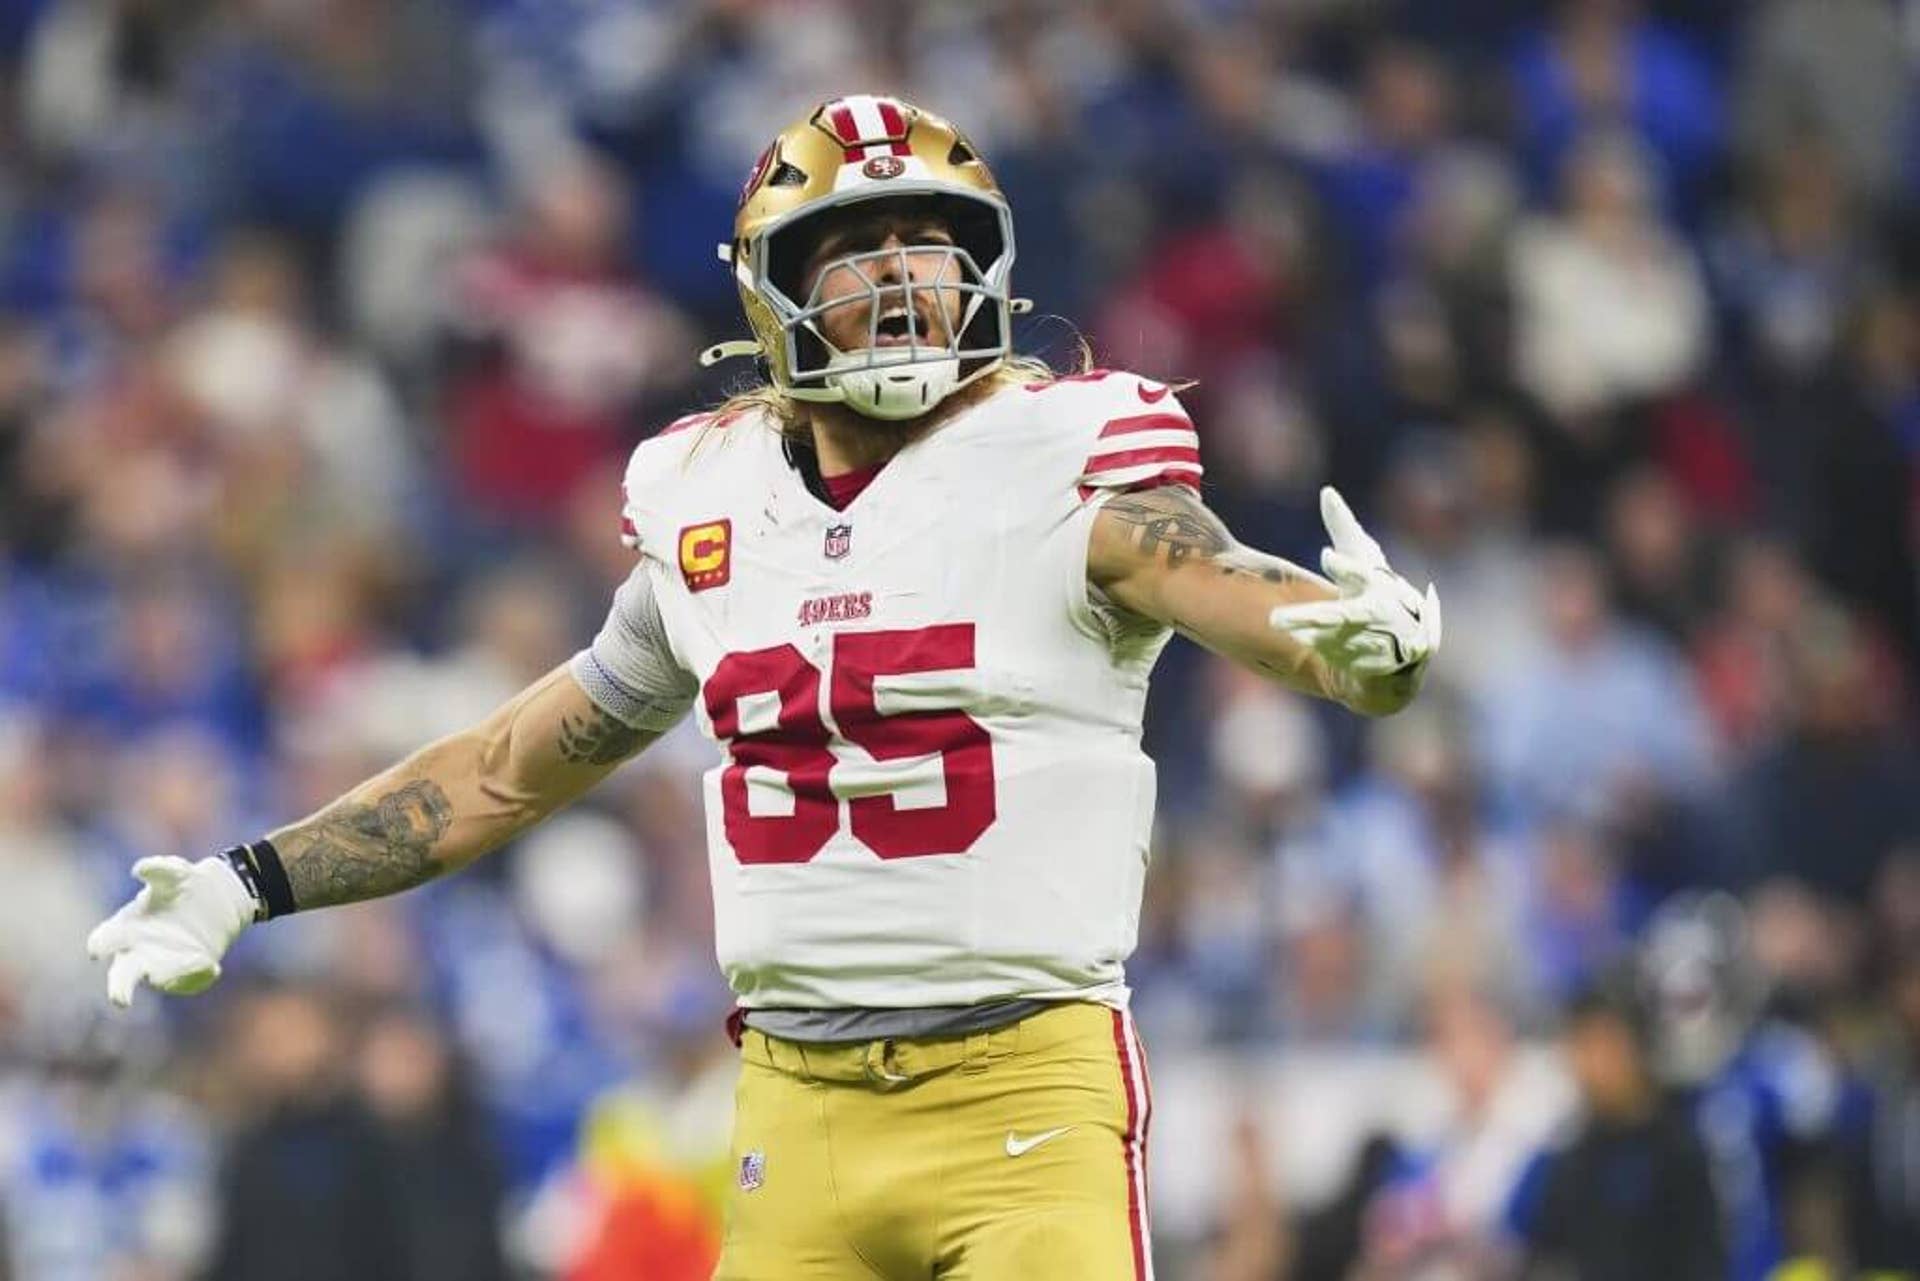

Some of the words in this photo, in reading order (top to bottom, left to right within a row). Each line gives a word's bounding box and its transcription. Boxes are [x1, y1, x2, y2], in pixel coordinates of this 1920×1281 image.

[681, 524, 725, 572] C
[798, 592, 872, 627] 49ERS
[703, 622, 996, 865] 85
